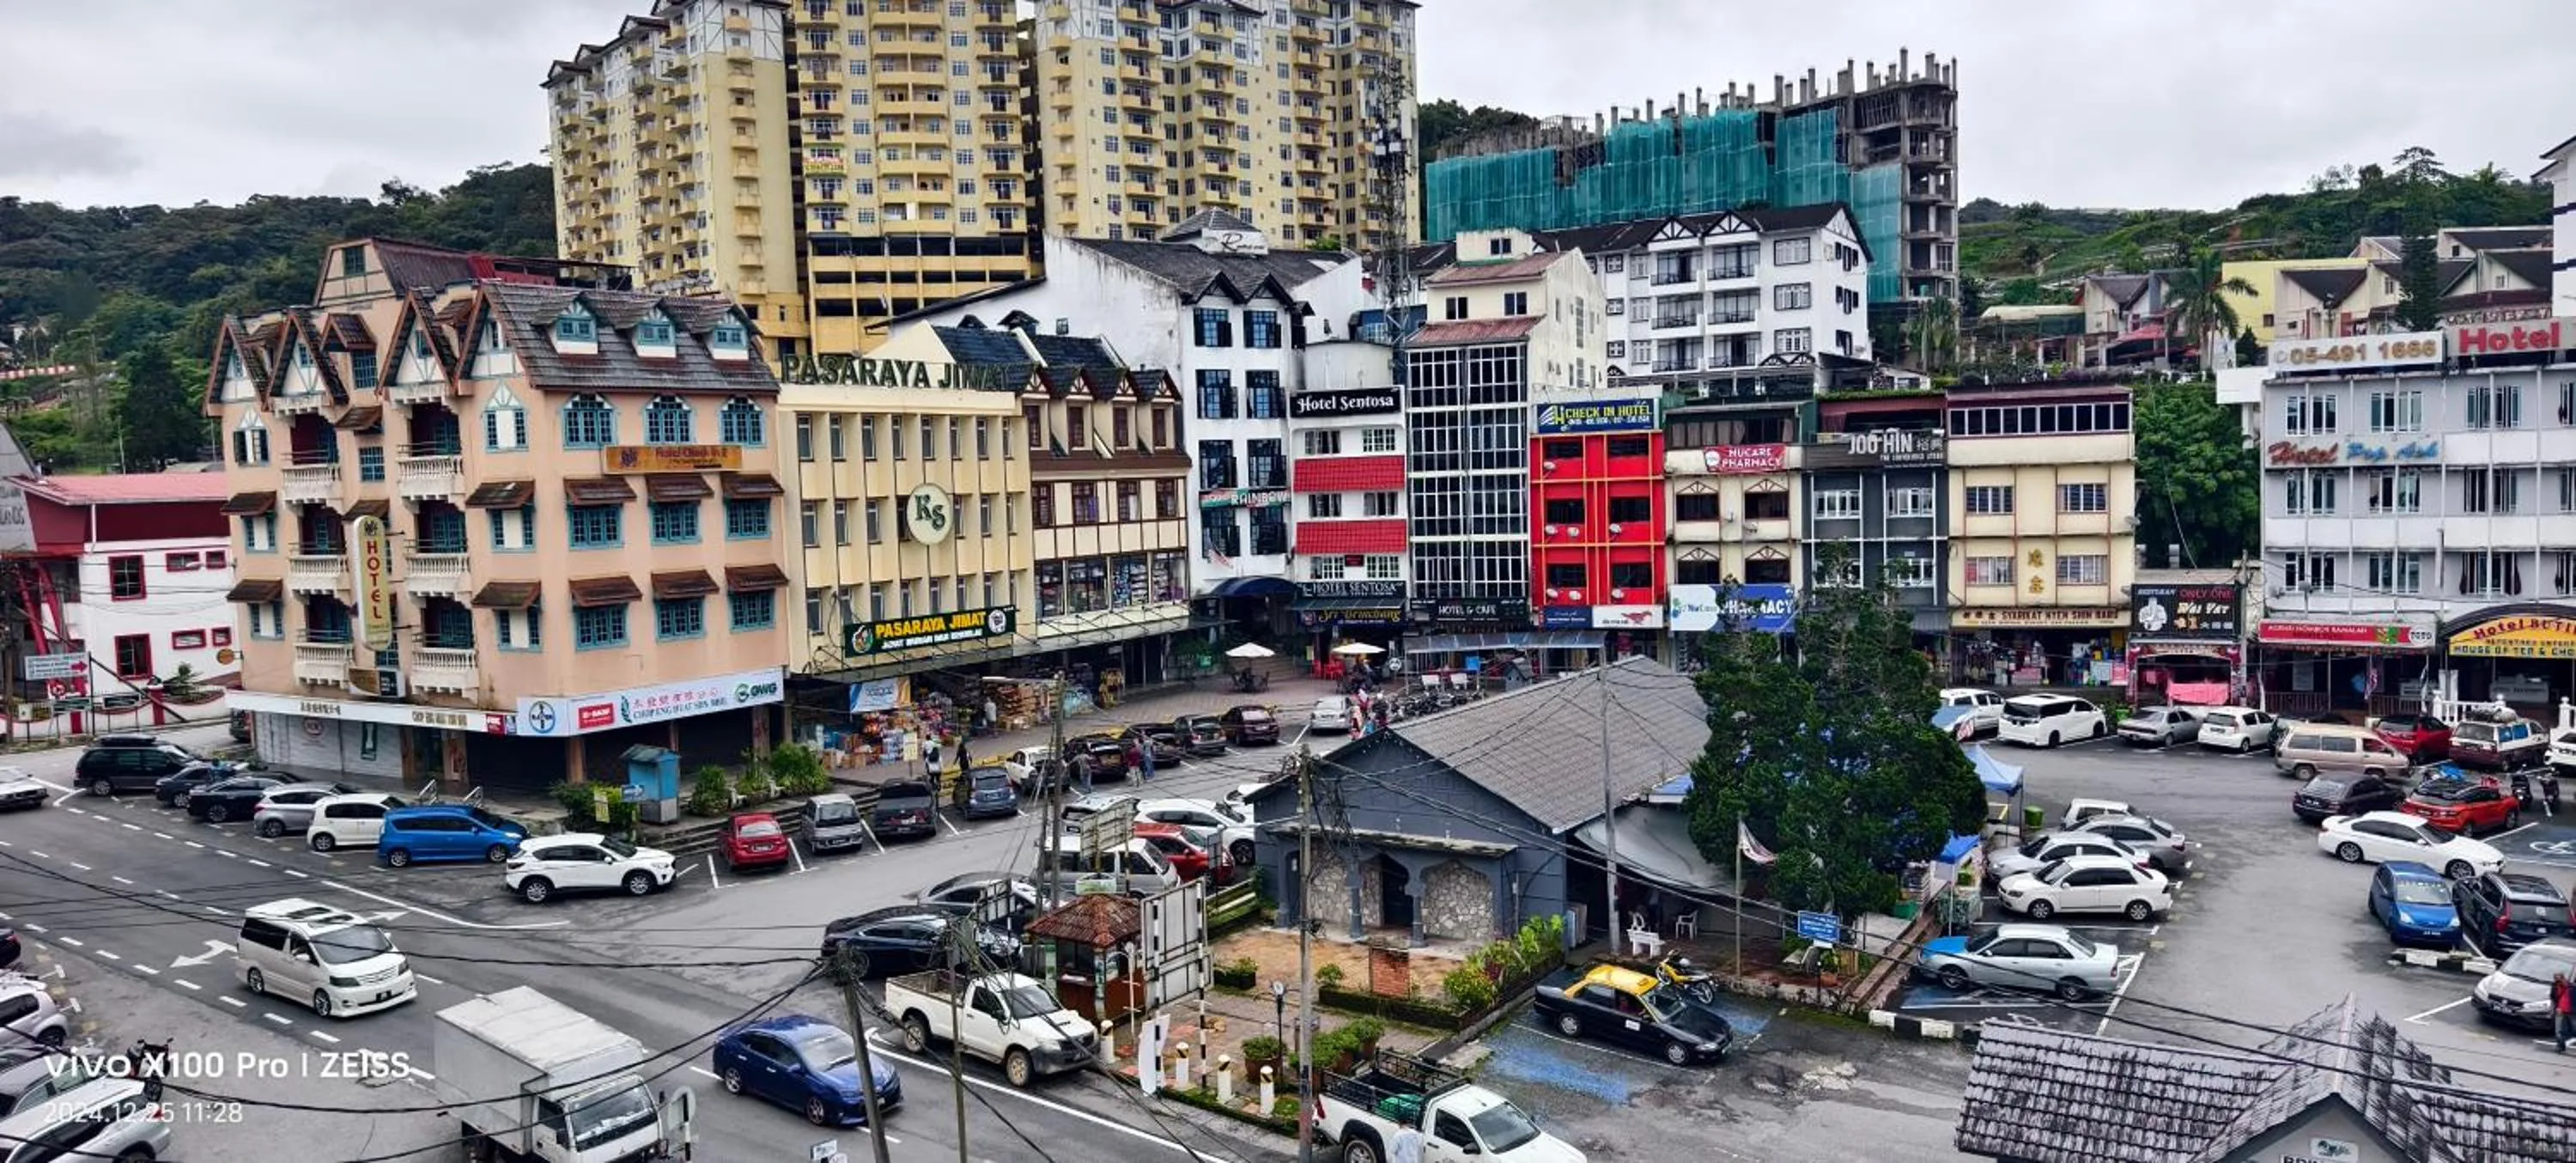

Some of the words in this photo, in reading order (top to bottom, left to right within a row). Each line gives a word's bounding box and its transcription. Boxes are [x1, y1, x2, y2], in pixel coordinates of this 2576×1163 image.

[2458, 322, 2561, 352] Hotel
[781, 354, 931, 388] PASARAYA
[938, 362, 1009, 391] JIMAT
[1297, 395, 1336, 413] Hotel
[1340, 395, 1394, 411] Sentosa
[1565, 408, 1600, 418] CHECK
[1603, 406, 1614, 416] IN
[1619, 405, 1649, 416] HOTEL
[1728, 447, 1772, 458] NUCARE
[1848, 434, 1879, 454] JOO
[1883, 432, 1913, 454] HIN
[1722, 457, 1782, 468] PHARMACY
[1230, 490, 1291, 506] RAINBOW
[367, 540, 382, 619] HOTEL
[1438, 605, 1463, 615] HOTEL
[875, 617, 946, 638] PASARAYA
[949, 612, 987, 629] JIMAT
[2473, 618, 2524, 640] Hotel
[2530, 618, 2576, 636] BUTI
